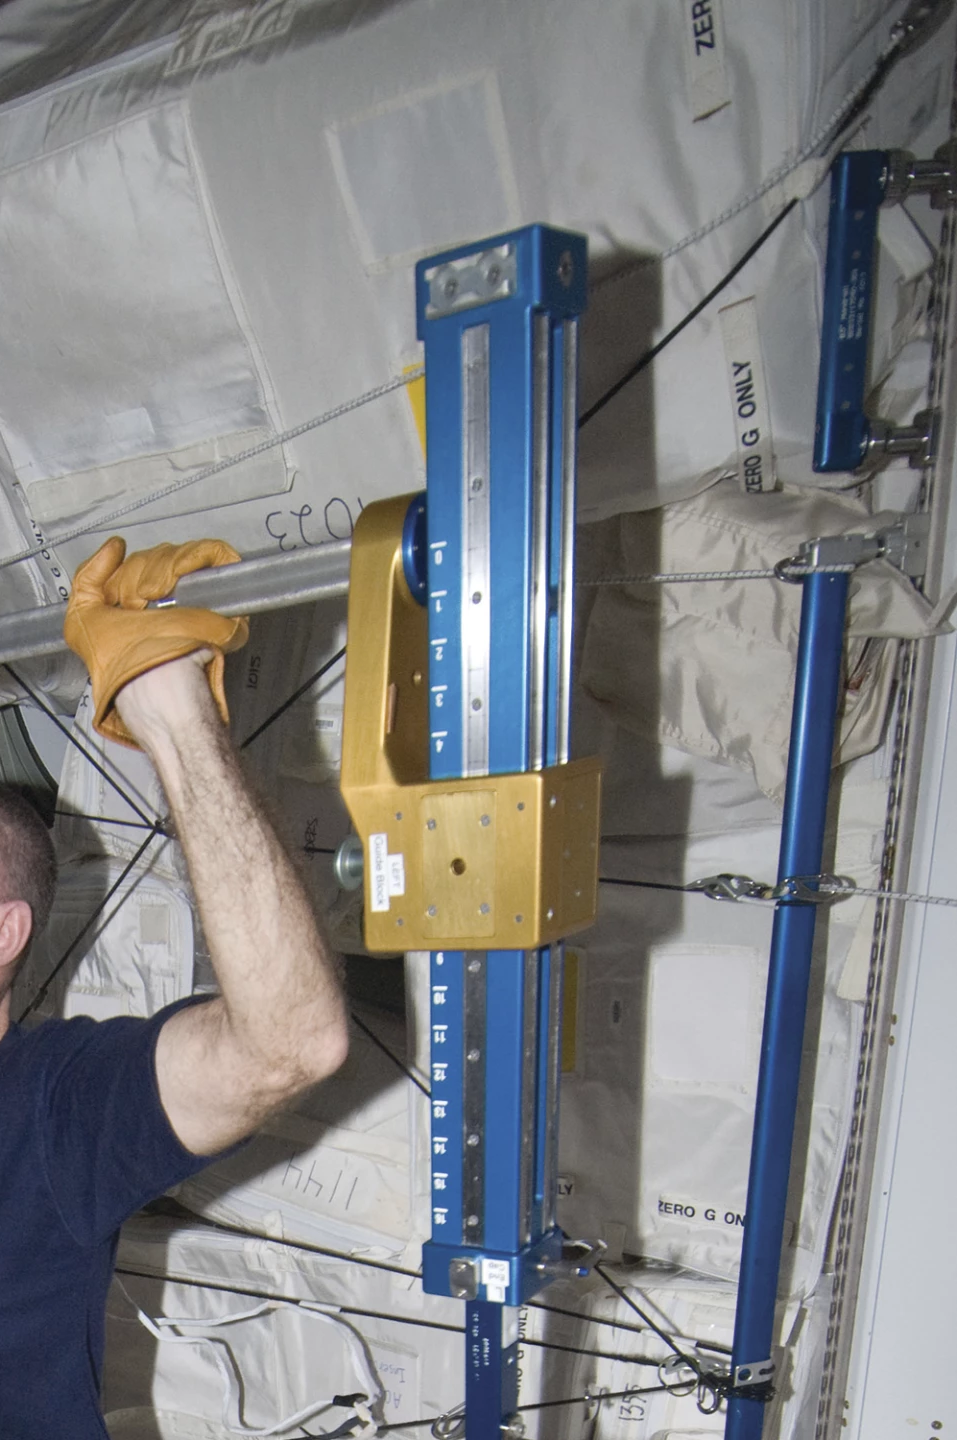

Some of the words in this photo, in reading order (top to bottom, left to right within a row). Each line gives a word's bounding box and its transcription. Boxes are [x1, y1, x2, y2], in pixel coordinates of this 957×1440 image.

[691, 0, 715, 56] ZER
[732, 361, 757, 419] ONLY
[741, 427, 760, 447] G
[744, 454, 763, 494] ZERO
[434, 646, 444, 661] 2
[434, 692, 444, 708] 3
[435, 738, 444, 754] 4
[374, 835, 384, 871] Guide
[375, 874, 385, 905] Block
[658, 1200, 696, 1218] ZERO
[704, 1208, 716, 1221] G
